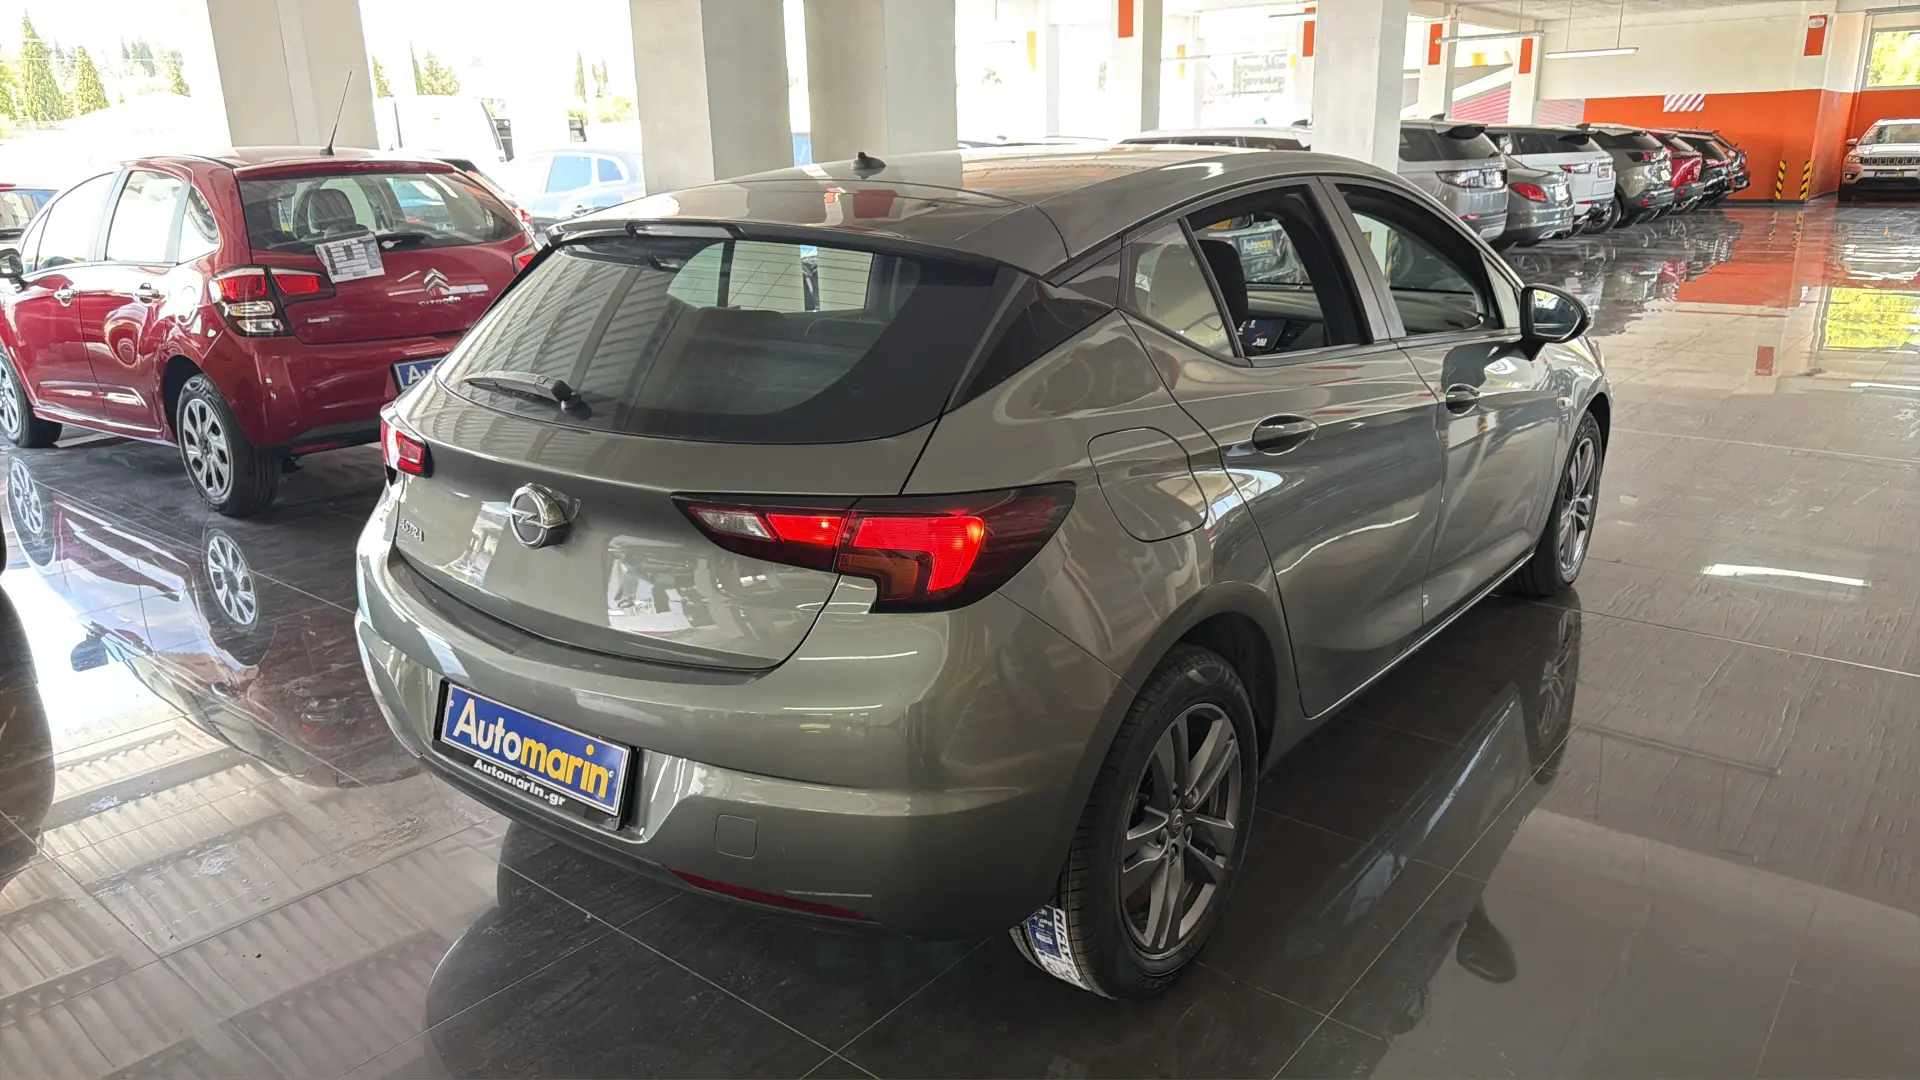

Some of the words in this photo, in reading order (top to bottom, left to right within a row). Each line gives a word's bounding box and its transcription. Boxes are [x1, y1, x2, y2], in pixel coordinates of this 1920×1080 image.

[400, 518, 425, 542] ASTRA
[453, 698, 608, 799] Automarin
[473, 757, 567, 807] Automarin.gr
